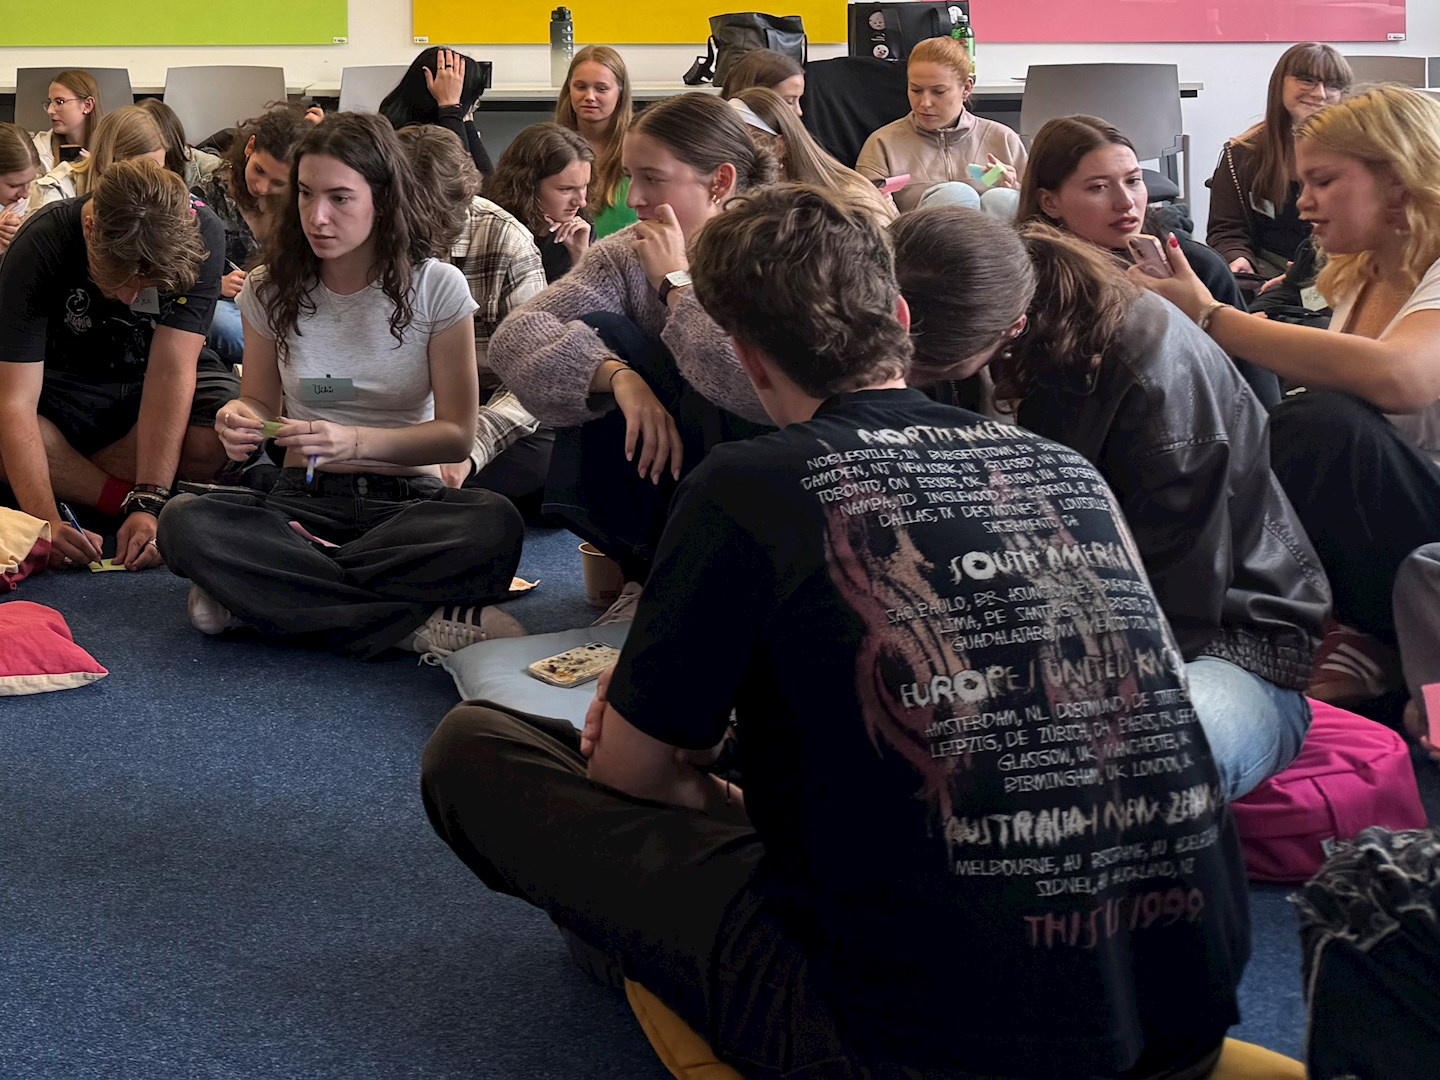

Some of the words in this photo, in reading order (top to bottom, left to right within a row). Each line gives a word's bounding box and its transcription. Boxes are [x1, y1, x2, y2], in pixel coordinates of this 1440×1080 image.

[857, 425, 952, 445] NORTH
[800, 464, 869, 490] CAMDEN,
[816, 480, 886, 504] TORONTO,
[888, 477, 910, 490] ON
[839, 497, 896, 517] NAMPA,
[898, 493, 917, 506] ID
[878, 508, 938, 528] DALLAS,
[948, 549, 1040, 585] SOUTH
[984, 609, 1007, 626] PE
[900, 665, 1020, 709] EUROPE
[925, 709, 1024, 738] AMSTERDAM,
[930, 733, 1003, 758] LEIPZIG,
[1005, 729, 1030, 747] DE
